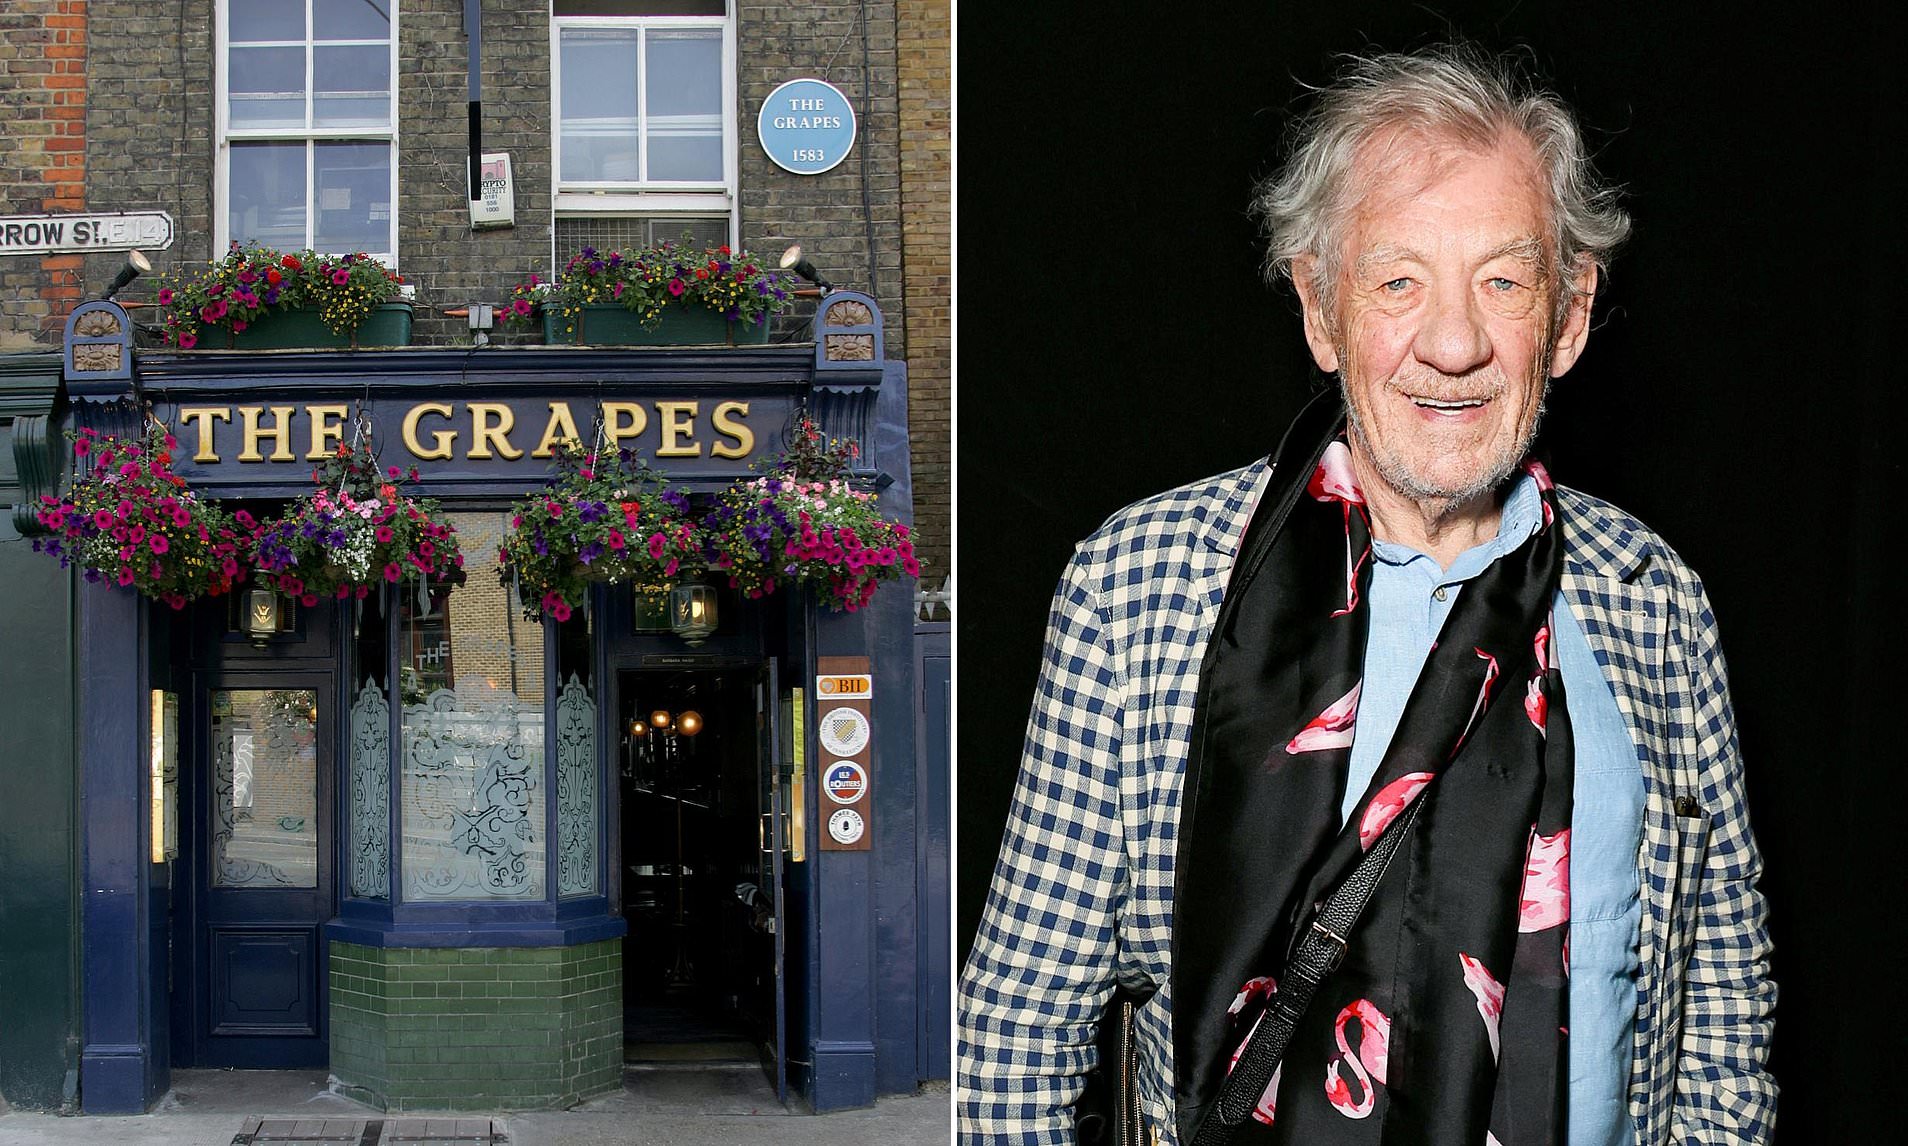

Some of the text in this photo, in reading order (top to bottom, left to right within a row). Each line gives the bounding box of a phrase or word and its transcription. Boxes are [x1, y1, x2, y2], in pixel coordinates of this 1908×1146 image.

[789, 99, 824, 111] THE
[774, 116, 841, 130] GRAPES
[793, 149, 824, 162] 1583
[0, 223, 64, 246] ROW
[180, 402, 756, 463] THE GRAPES
[415, 640, 450, 671] THE
[840, 679, 861, 693] BII
